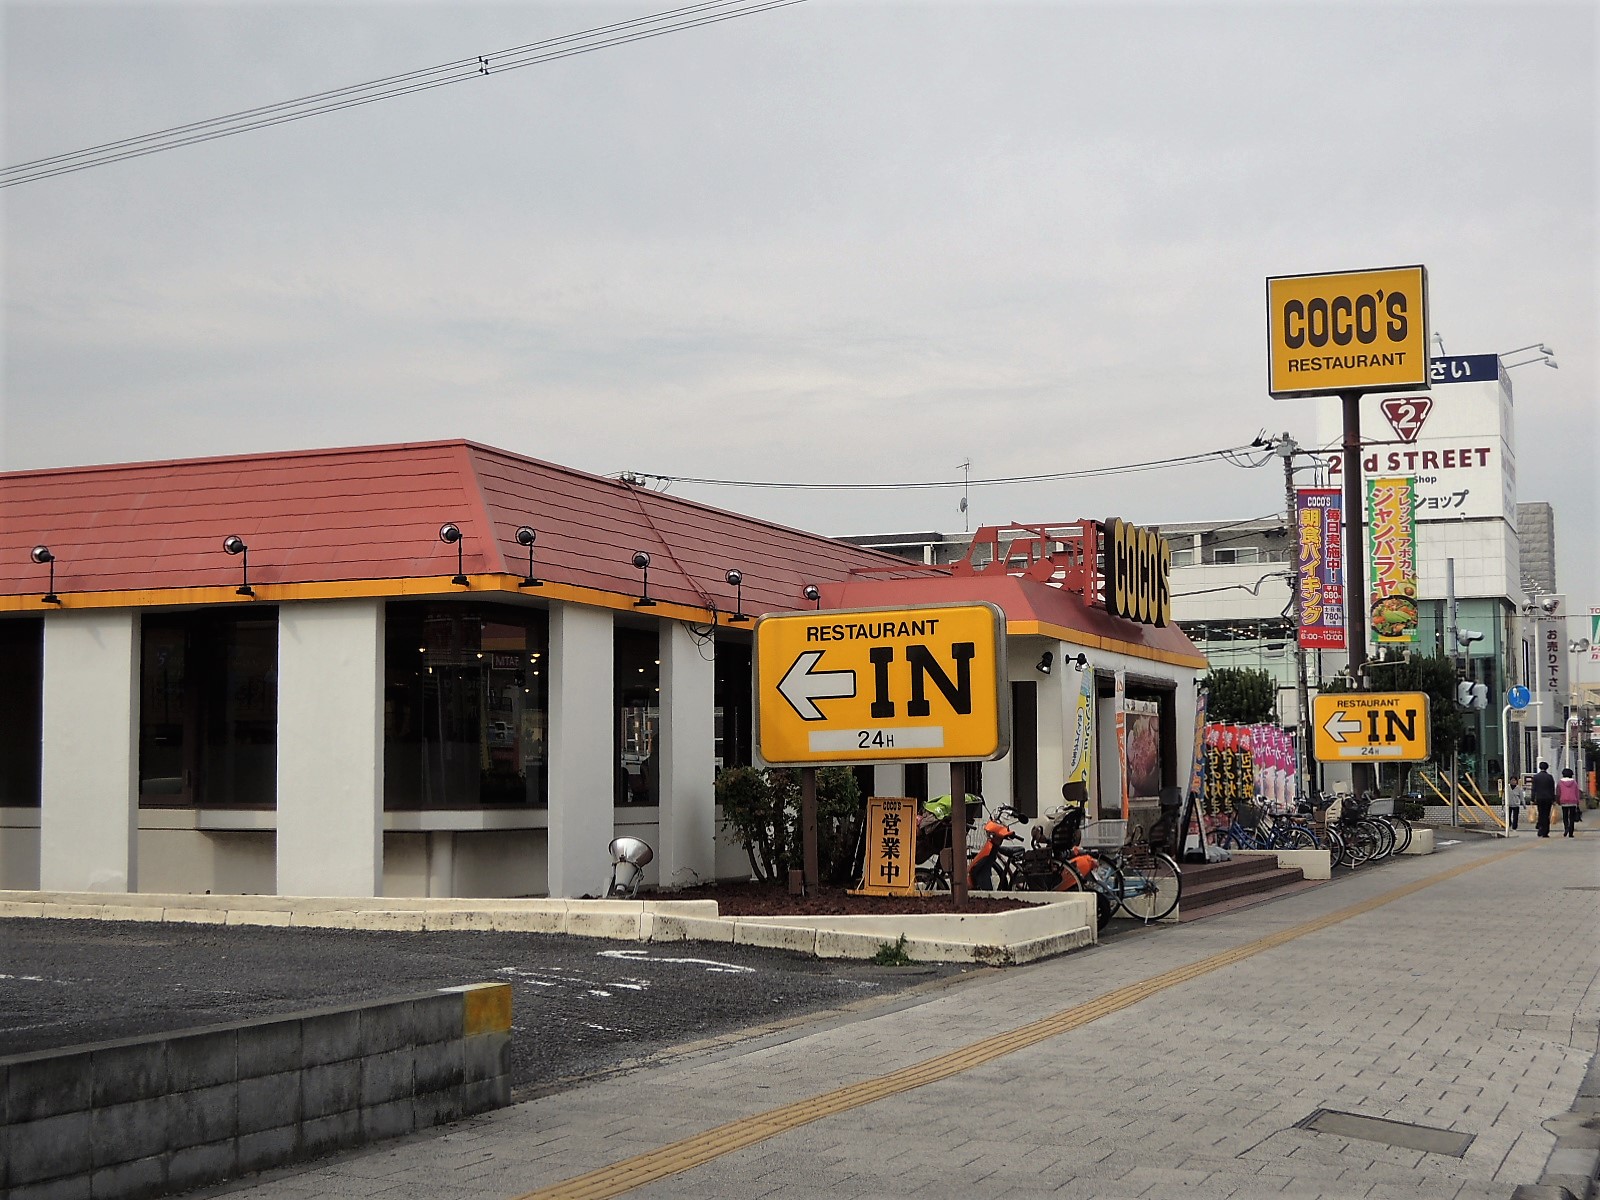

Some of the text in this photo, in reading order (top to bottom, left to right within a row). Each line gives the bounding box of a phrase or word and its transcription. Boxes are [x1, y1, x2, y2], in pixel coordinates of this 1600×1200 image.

[1283, 289, 1408, 349] COCO'S
[1288, 352, 1406, 373] RESTAURANT
[1328, 453, 1378, 474] 2d
[1387, 448, 1491, 471] STREET
[1307, 496, 1331, 507] COCO'S
[1371, 486, 1397, 598] ジャンバラヤ
[1397, 486, 1413, 580] フレッシュ アボカド
[1299, 508, 1323, 625] 朝食バイキング
[806, 618, 940, 643] RESTAURANT
[869, 641, 976, 719] IN
[1337, 698, 1400, 708] RESTAURANT
[1367, 709, 1417, 742] IN
[857, 730, 895, 750] 24H
[1361, 747, 1380, 756] 24H
[882, 801, 902, 811] COCO'S
[880, 813, 902, 884] 営業中
